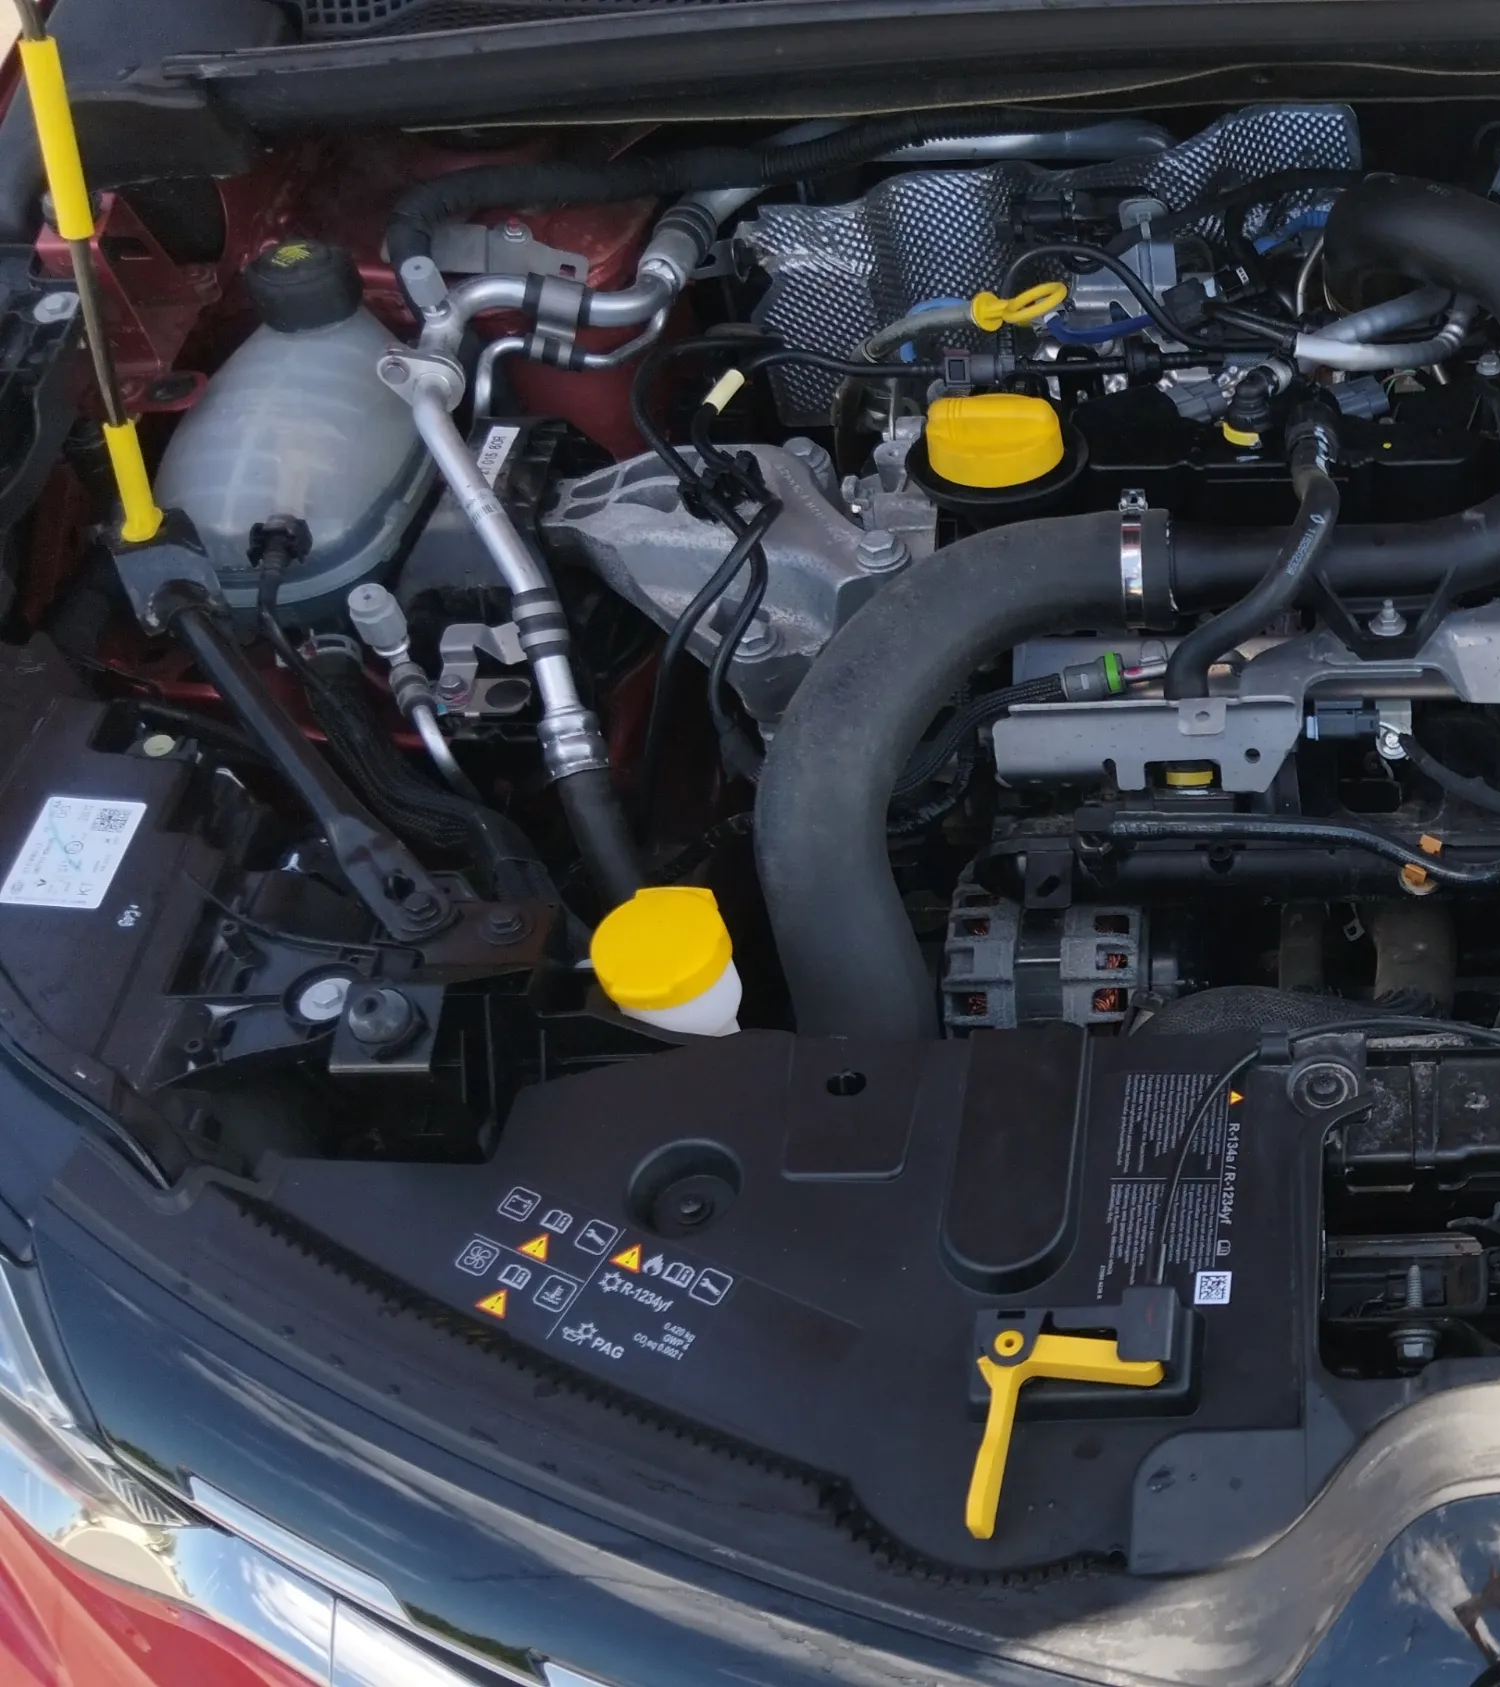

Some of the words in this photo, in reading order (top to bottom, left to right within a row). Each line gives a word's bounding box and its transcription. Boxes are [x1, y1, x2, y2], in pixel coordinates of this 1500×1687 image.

[1225, 1123, 1240, 1163] R-134a
[1219, 1172, 1236, 1225] R-1234yf
[620, 1281, 674, 1312] R-1234yf
[663, 1322, 685, 1336] 0.420
[684, 1331, 696, 1343] kg
[663, 1334, 684, 1347] GWP
[591, 1337, 625, 1359] PAG
[657, 1343, 681, 1359] 0.002
